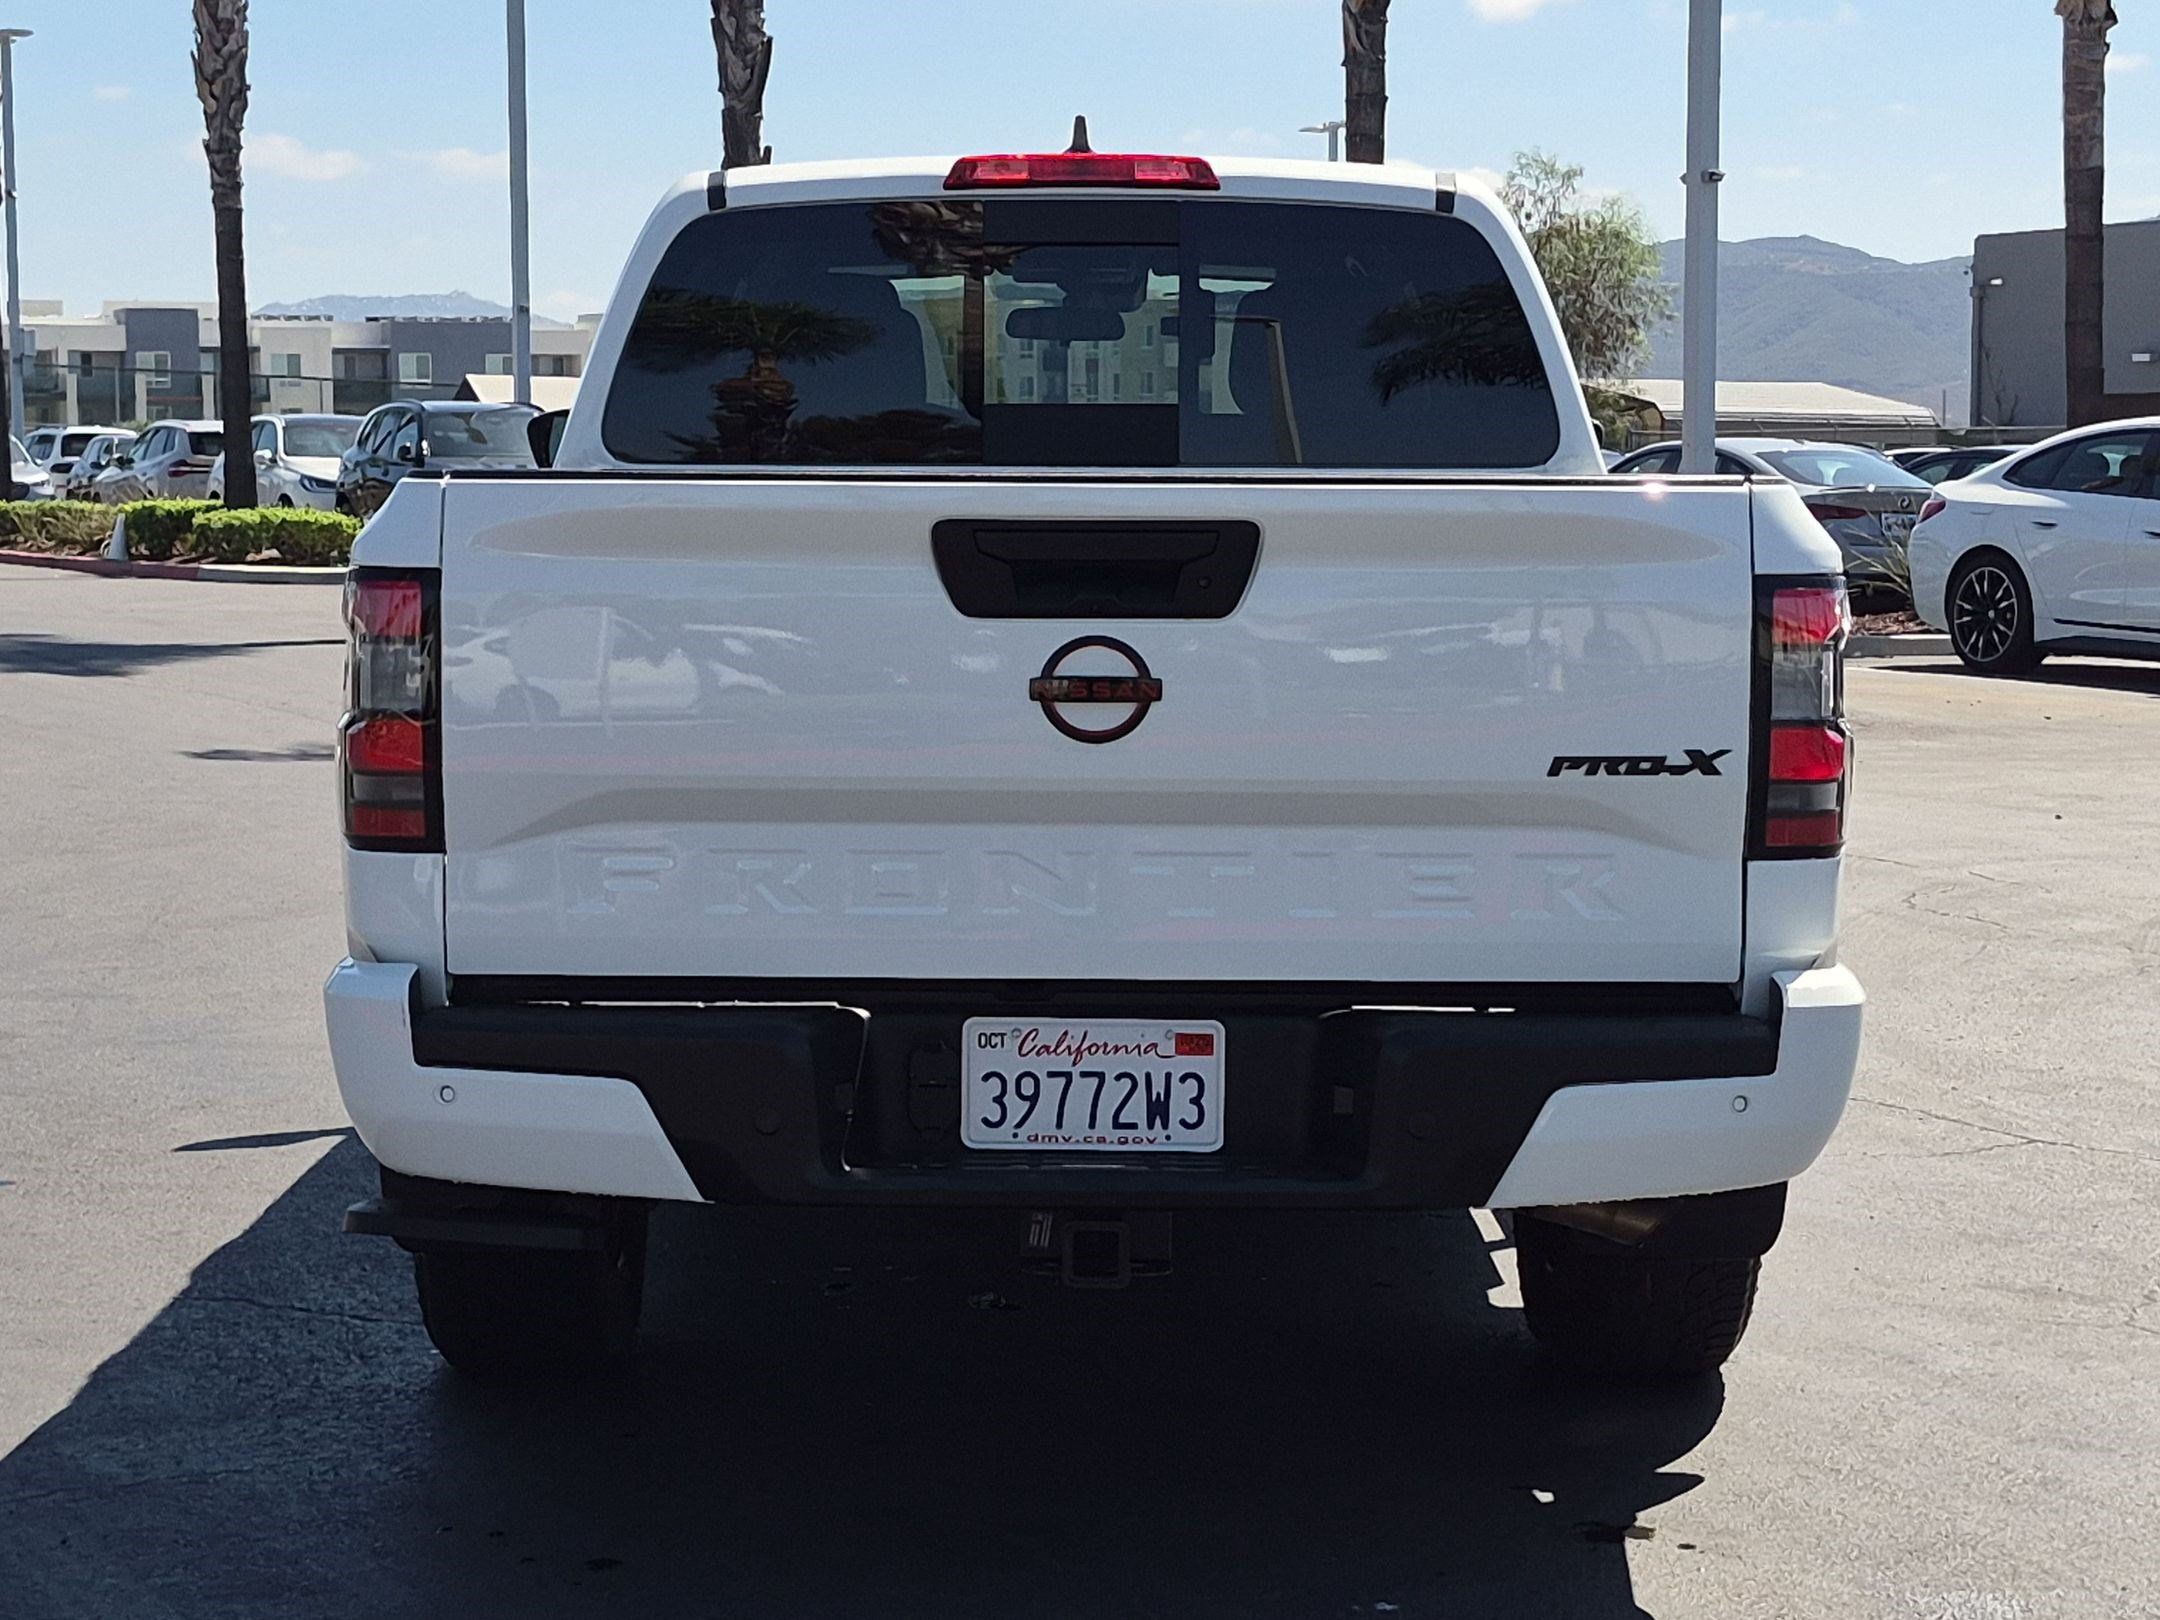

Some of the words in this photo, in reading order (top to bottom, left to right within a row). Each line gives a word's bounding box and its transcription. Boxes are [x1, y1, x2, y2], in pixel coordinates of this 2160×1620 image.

[1546, 748, 1734, 778] PRO-X
[977, 1031, 1008, 1049] OCT
[1017, 1027, 1177, 1067] California
[980, 1070, 1206, 1131] 39772W3
[1026, 1133, 1158, 1146] dmv.ca.gov
